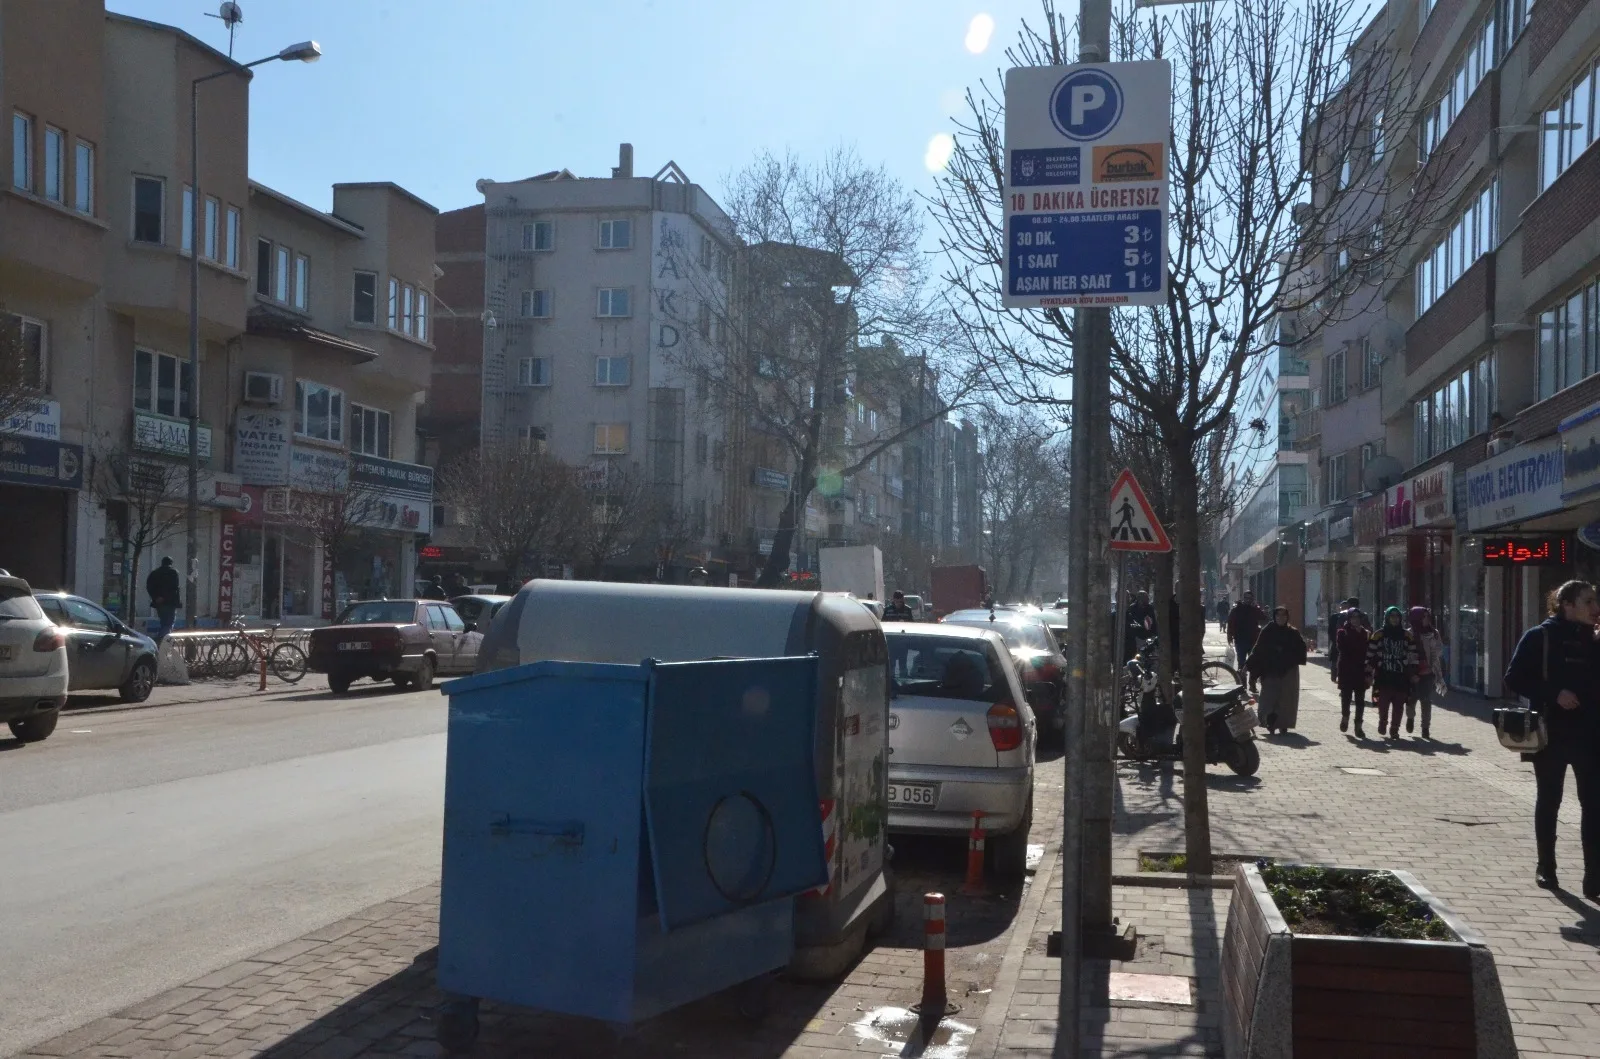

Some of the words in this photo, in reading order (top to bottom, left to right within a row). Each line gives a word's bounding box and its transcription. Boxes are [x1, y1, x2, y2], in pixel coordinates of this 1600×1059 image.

[1070, 85, 1106, 126] P
[1107, 160, 1147, 173] burbak
[1011, 193, 1026, 211] 10
[1033, 191, 1085, 211] DAKİKA
[1091, 186, 1160, 209] ÜCRETSİZ
[1016, 232, 1032, 247] 30
[1036, 231, 1056, 246] DK.
[1124, 225, 1140, 244] 3
[1017, 255, 1023, 269] 1
[1028, 254, 1059, 268] SAAT
[1124, 248, 1140, 267] 5
[1016, 276, 1050, 293] AŞAN
[1053, 275, 1077, 290] HER
[1080, 274, 1112, 290] SAAT
[1125, 270, 1137, 289] 1
[238, 429, 287, 444] VATEL
[219, 523, 235, 613] ECZANE
[903, 787, 931, 803] 056
